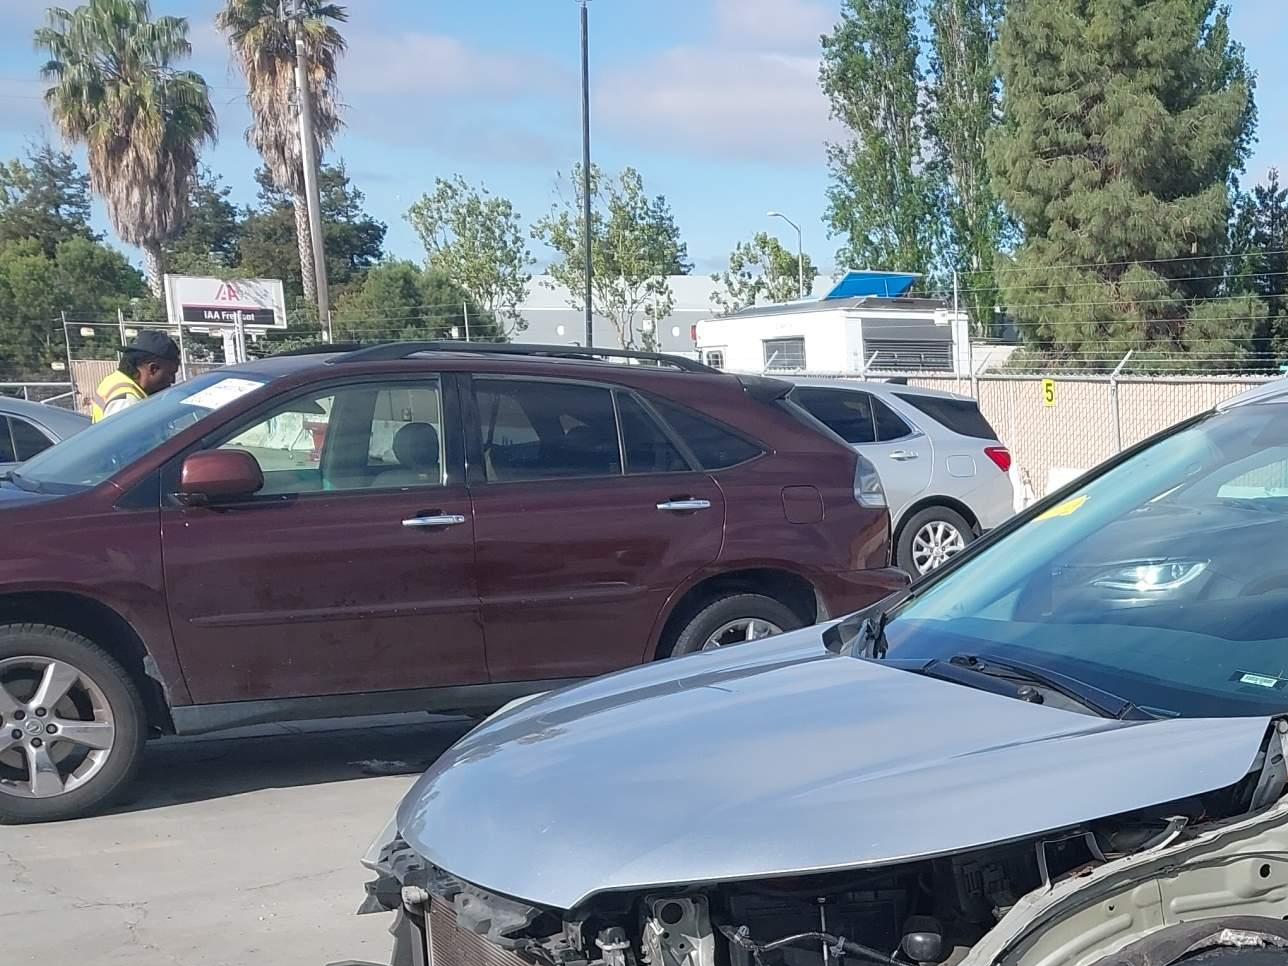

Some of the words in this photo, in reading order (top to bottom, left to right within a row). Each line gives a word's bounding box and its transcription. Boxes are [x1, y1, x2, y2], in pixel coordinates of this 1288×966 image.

[203, 310, 220, 320] IAA
[222, 311, 255, 321] Freont
[1046, 383, 1053, 402] 5
